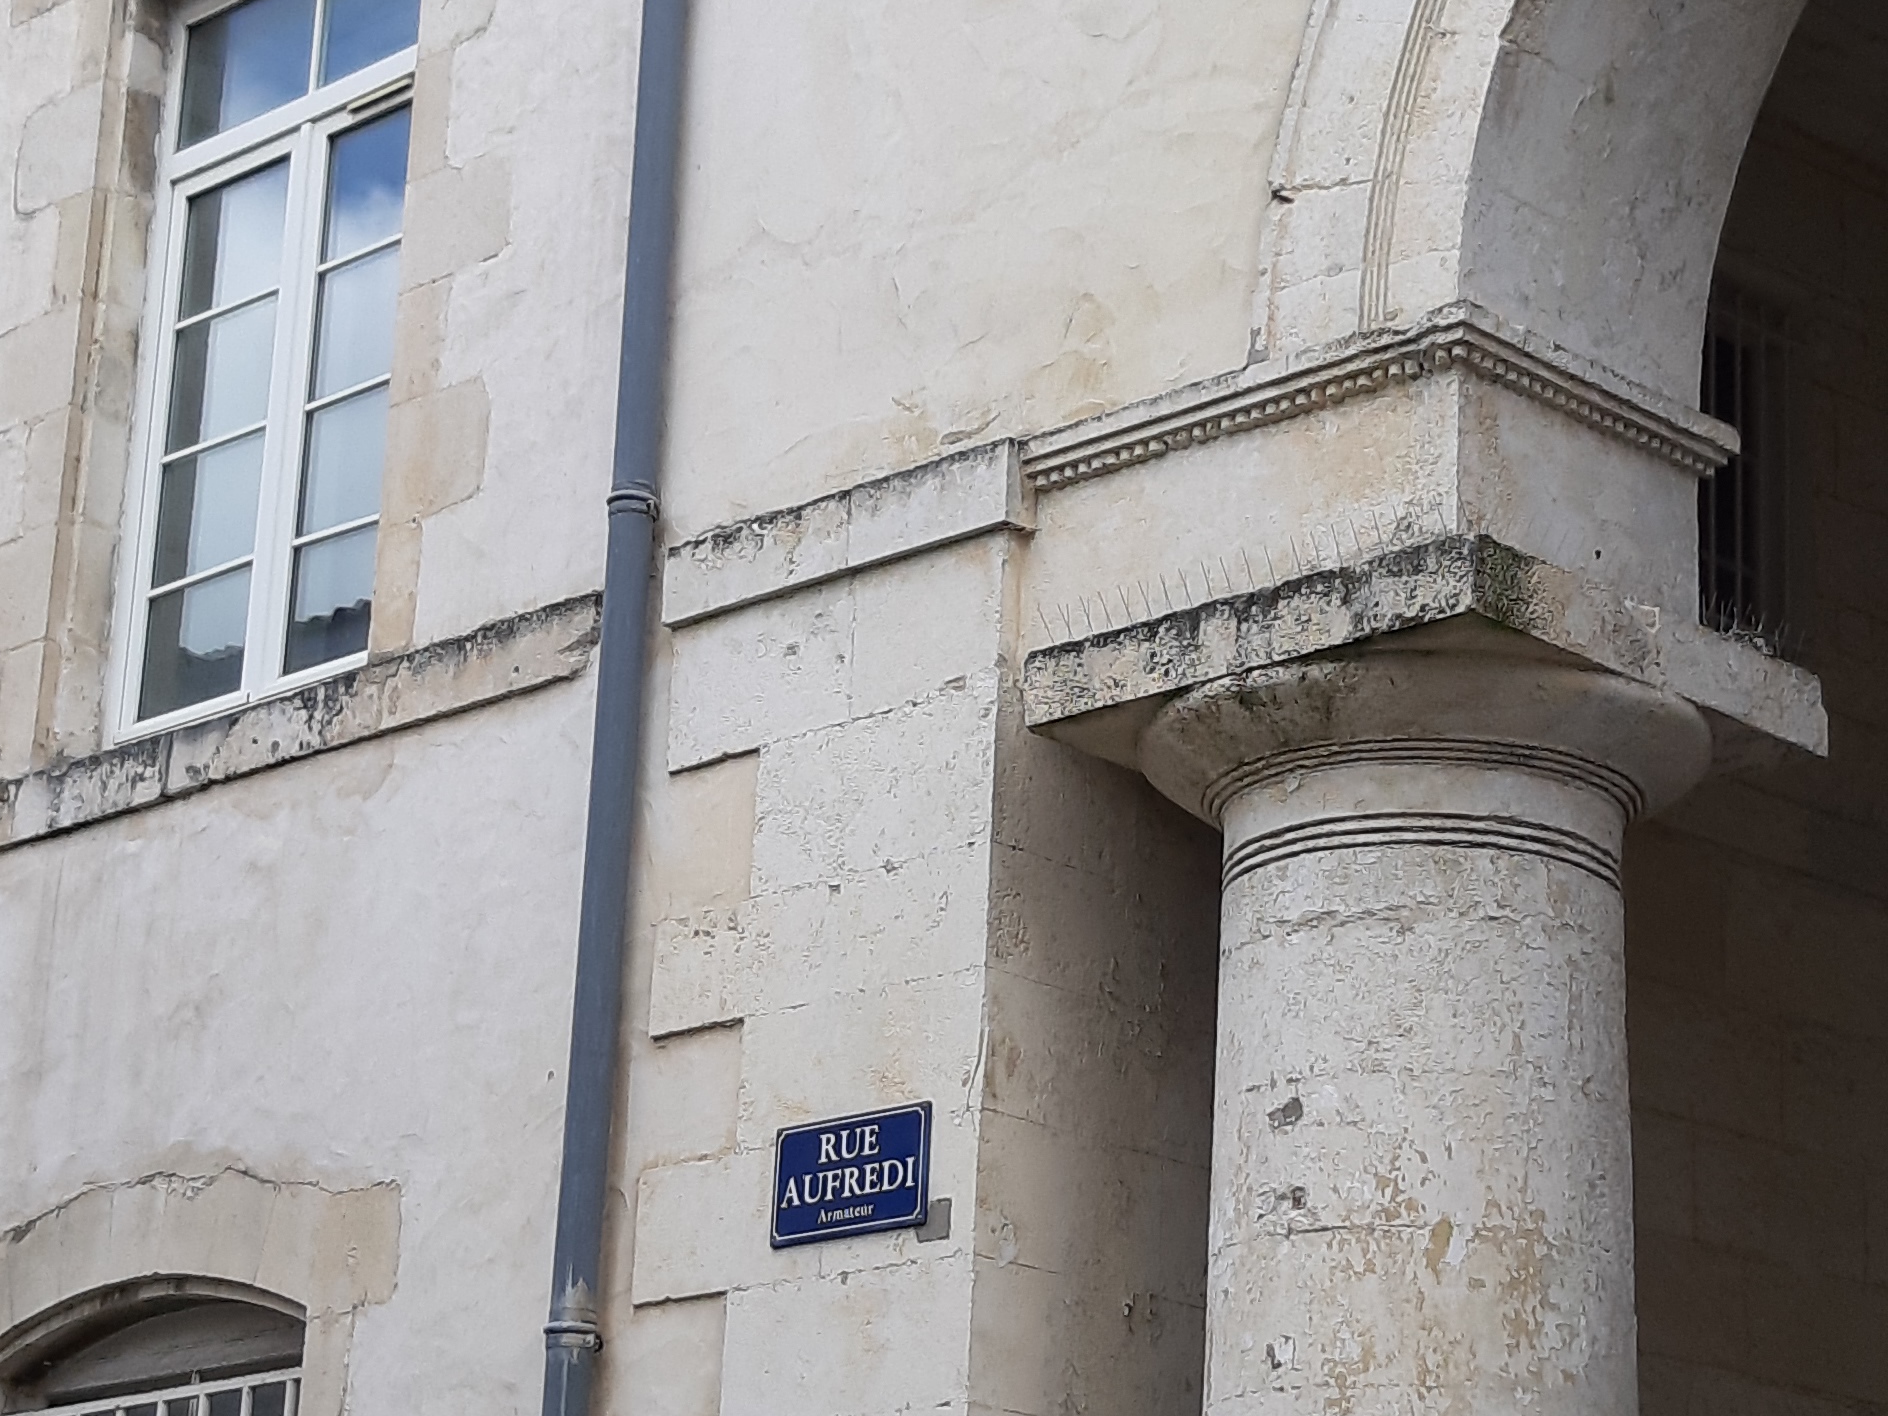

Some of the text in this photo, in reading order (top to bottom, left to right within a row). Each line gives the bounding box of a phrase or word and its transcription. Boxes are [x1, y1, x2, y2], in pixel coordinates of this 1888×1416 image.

[818, 1125, 879, 1163] RUE
[780, 1156, 915, 1208] AUFREDI
[817, 1203, 874, 1224] Armateur
